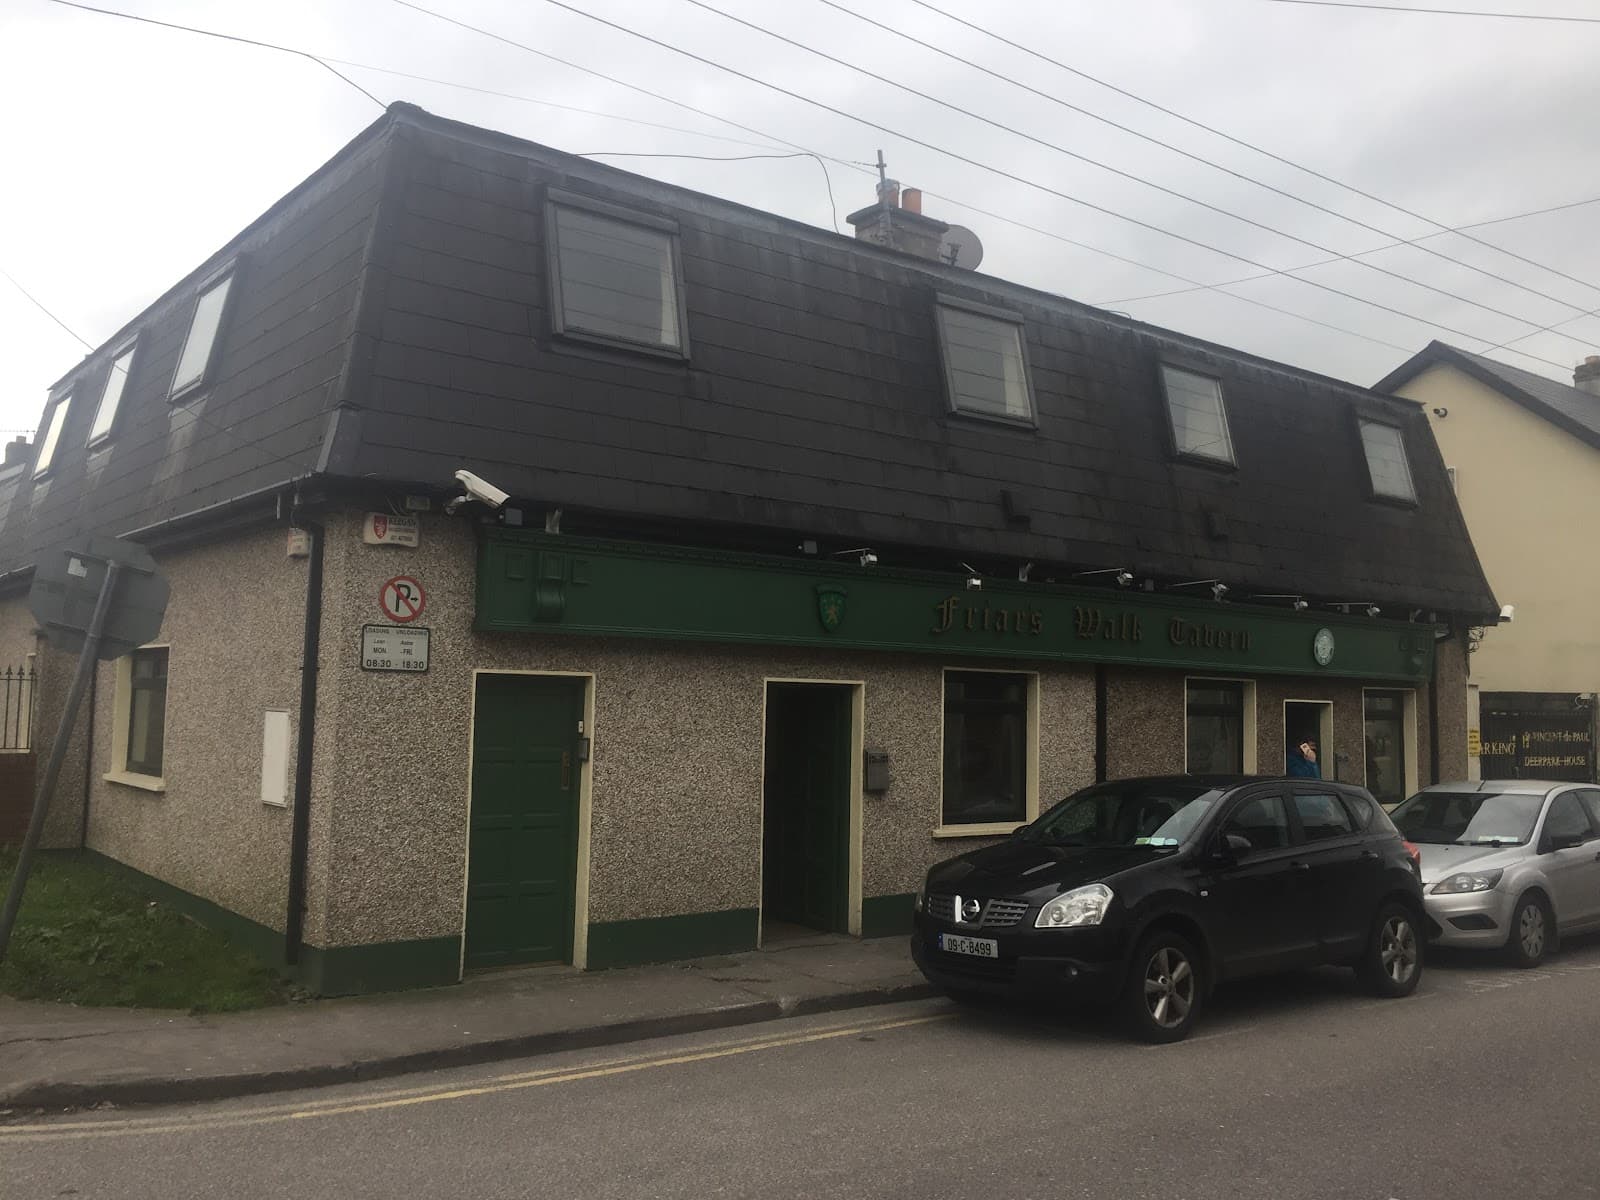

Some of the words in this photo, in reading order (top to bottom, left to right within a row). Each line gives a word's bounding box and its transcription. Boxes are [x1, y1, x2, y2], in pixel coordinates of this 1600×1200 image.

[1075, 606, 1144, 643] Walk
[1169, 616, 1255, 651] Tavern
[366, 659, 392, 668] 08:30
[402, 660, 425, 669] 18:30
[947, 938, 992, 956] 09-C-8499
